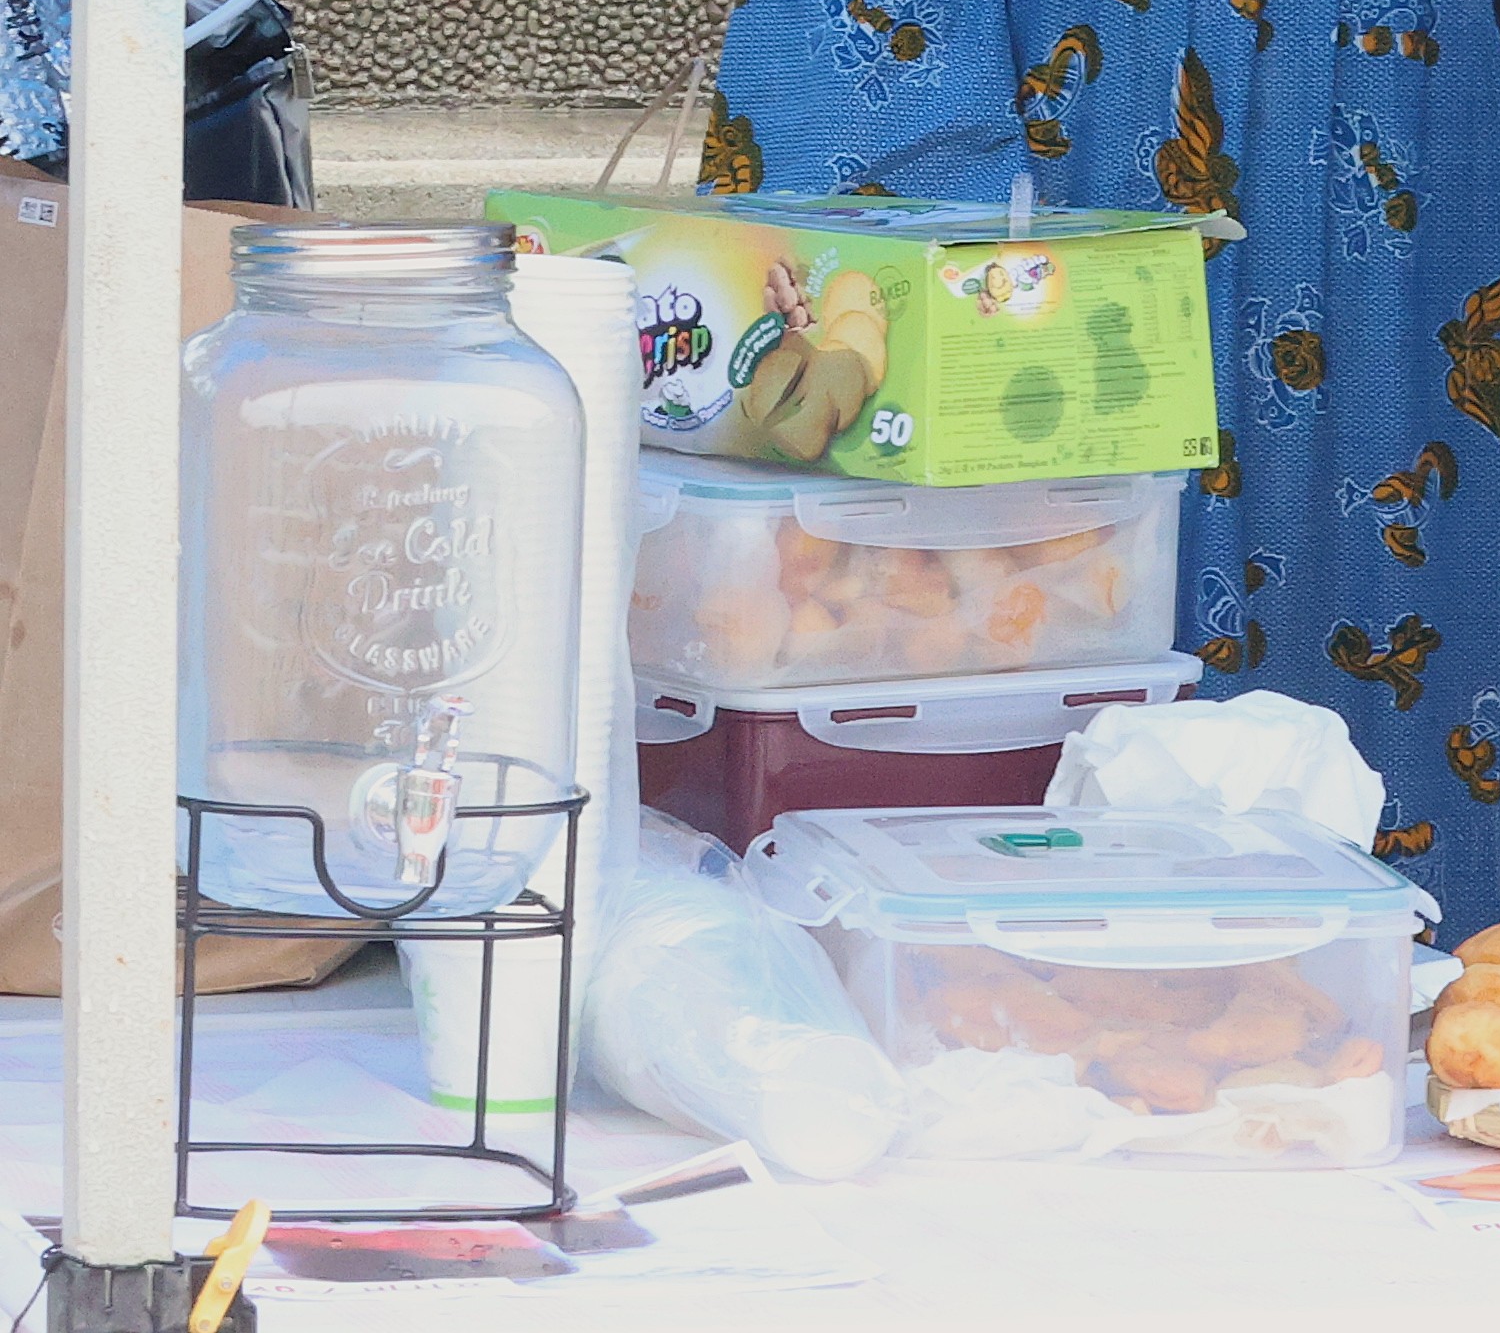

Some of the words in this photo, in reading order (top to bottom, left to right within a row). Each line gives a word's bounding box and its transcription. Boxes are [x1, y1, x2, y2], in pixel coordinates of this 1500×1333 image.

[870, 279, 911, 307] BAKED
[870, 409, 913, 447] 50
[405, 515, 494, 565] Cold
[335, 616, 492, 674] GLASSWARE
